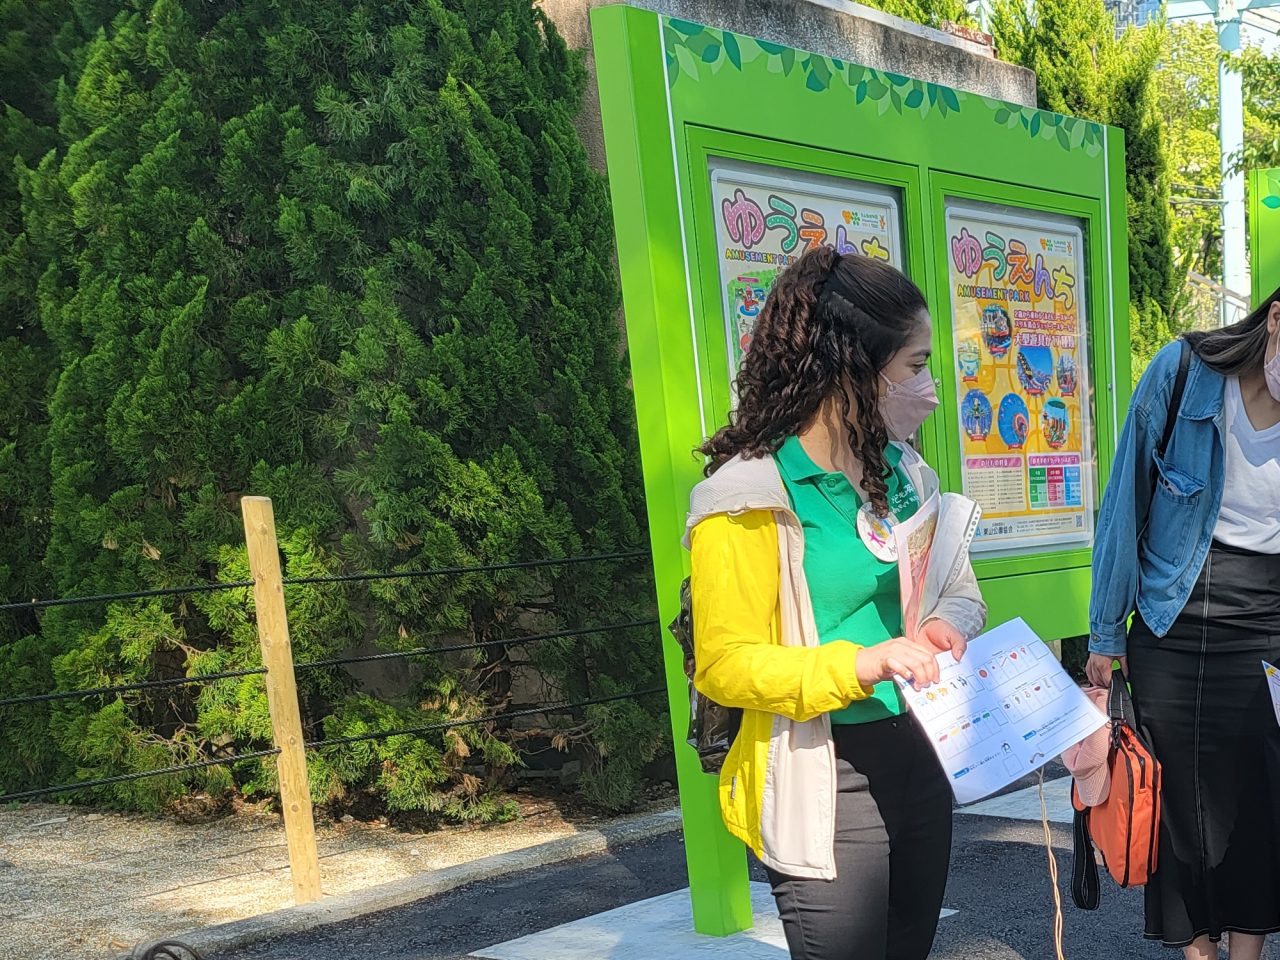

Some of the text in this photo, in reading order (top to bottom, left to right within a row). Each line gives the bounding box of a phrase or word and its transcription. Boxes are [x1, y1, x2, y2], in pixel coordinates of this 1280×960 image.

[725, 247, 779, 266] AMUSEMENT
[951, 227, 1075, 311] ゆうえんち
[957, 284, 1031, 303] AMUSEMENT PARK
